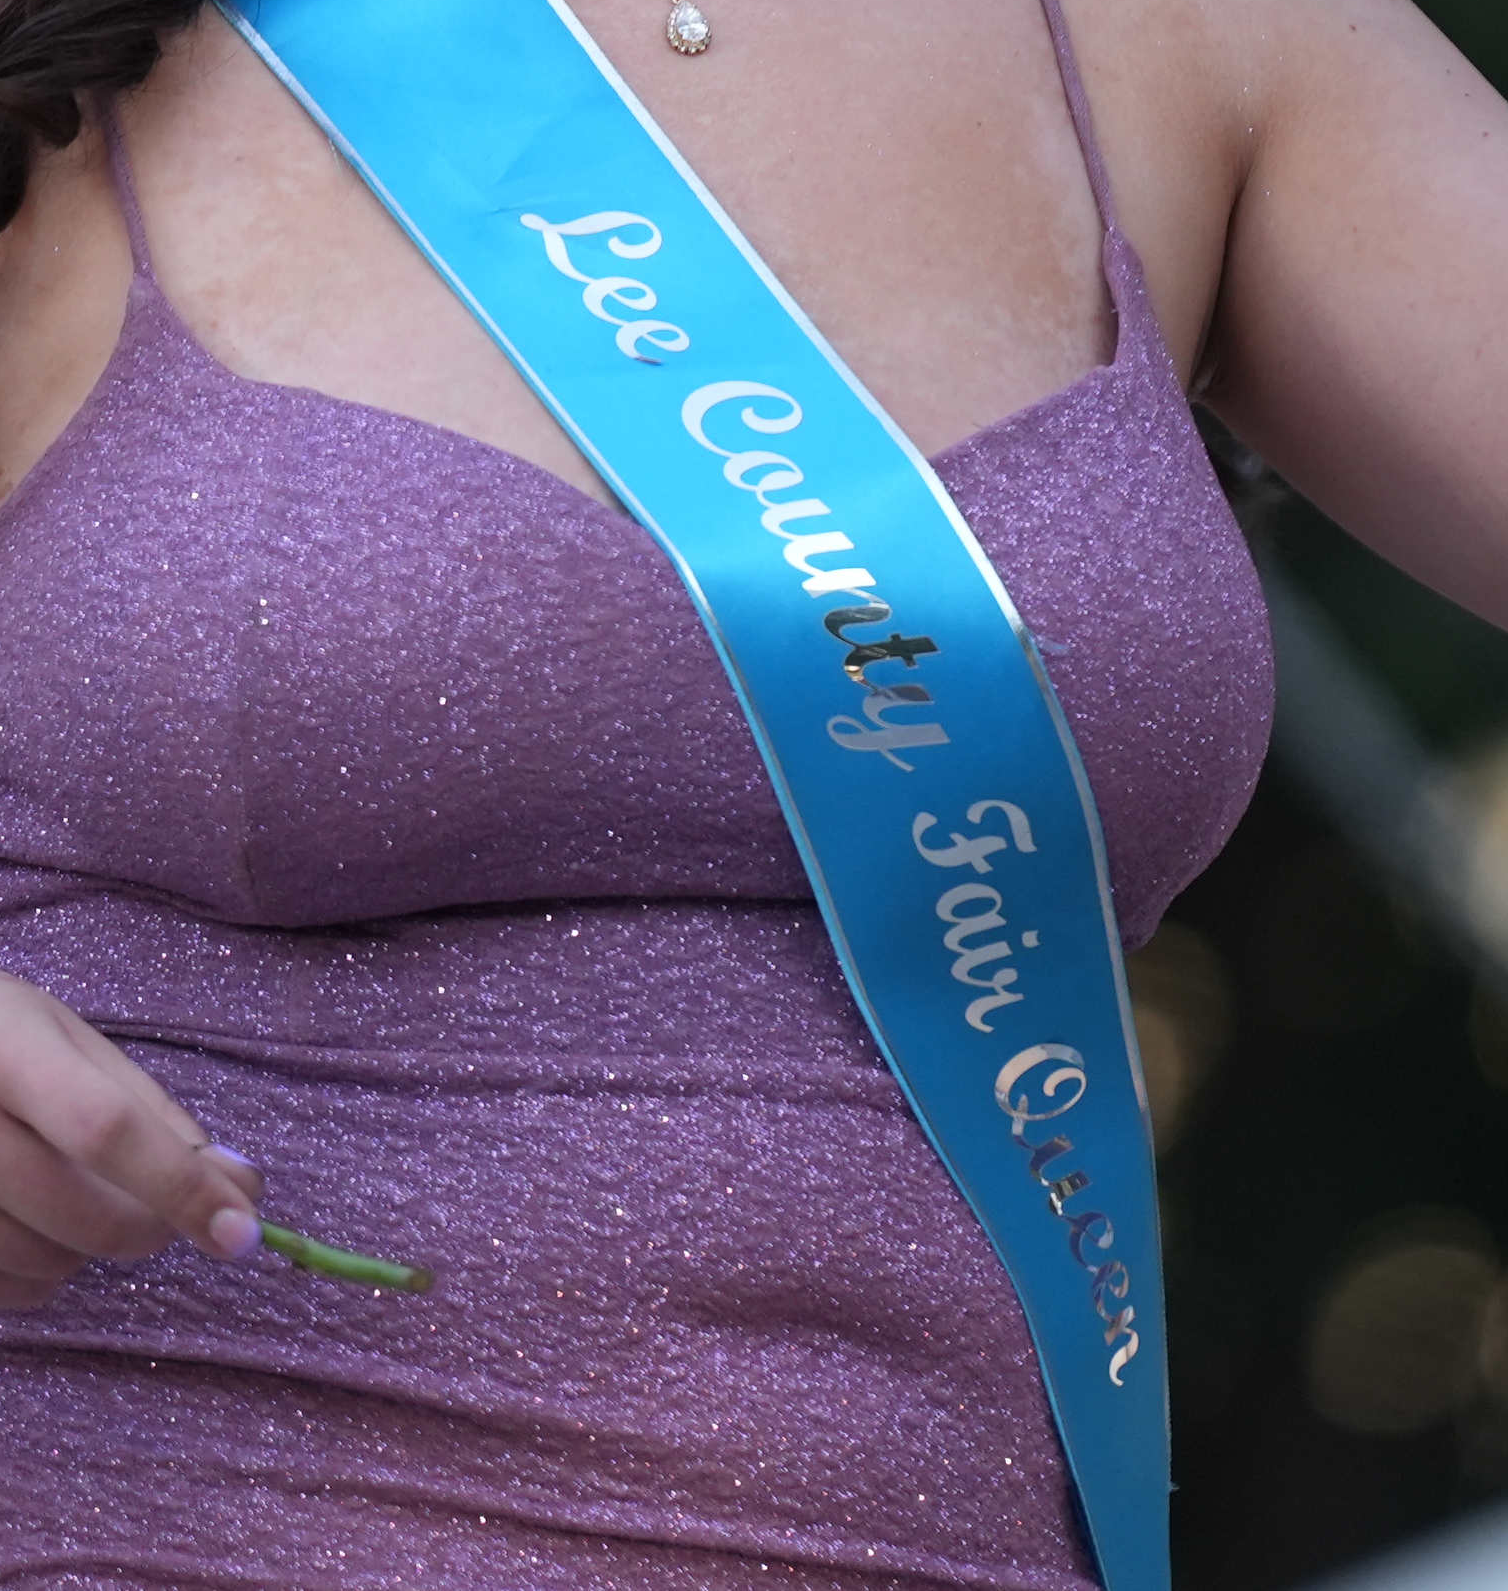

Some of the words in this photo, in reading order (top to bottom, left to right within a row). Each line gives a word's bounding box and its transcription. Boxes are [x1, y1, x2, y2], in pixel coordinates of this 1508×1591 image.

[521, 210, 690, 365] Lee
[681, 380, 951, 772] County
[911, 799, 1040, 1033] Fair
[993, 1042, 1140, 1386] Queen
